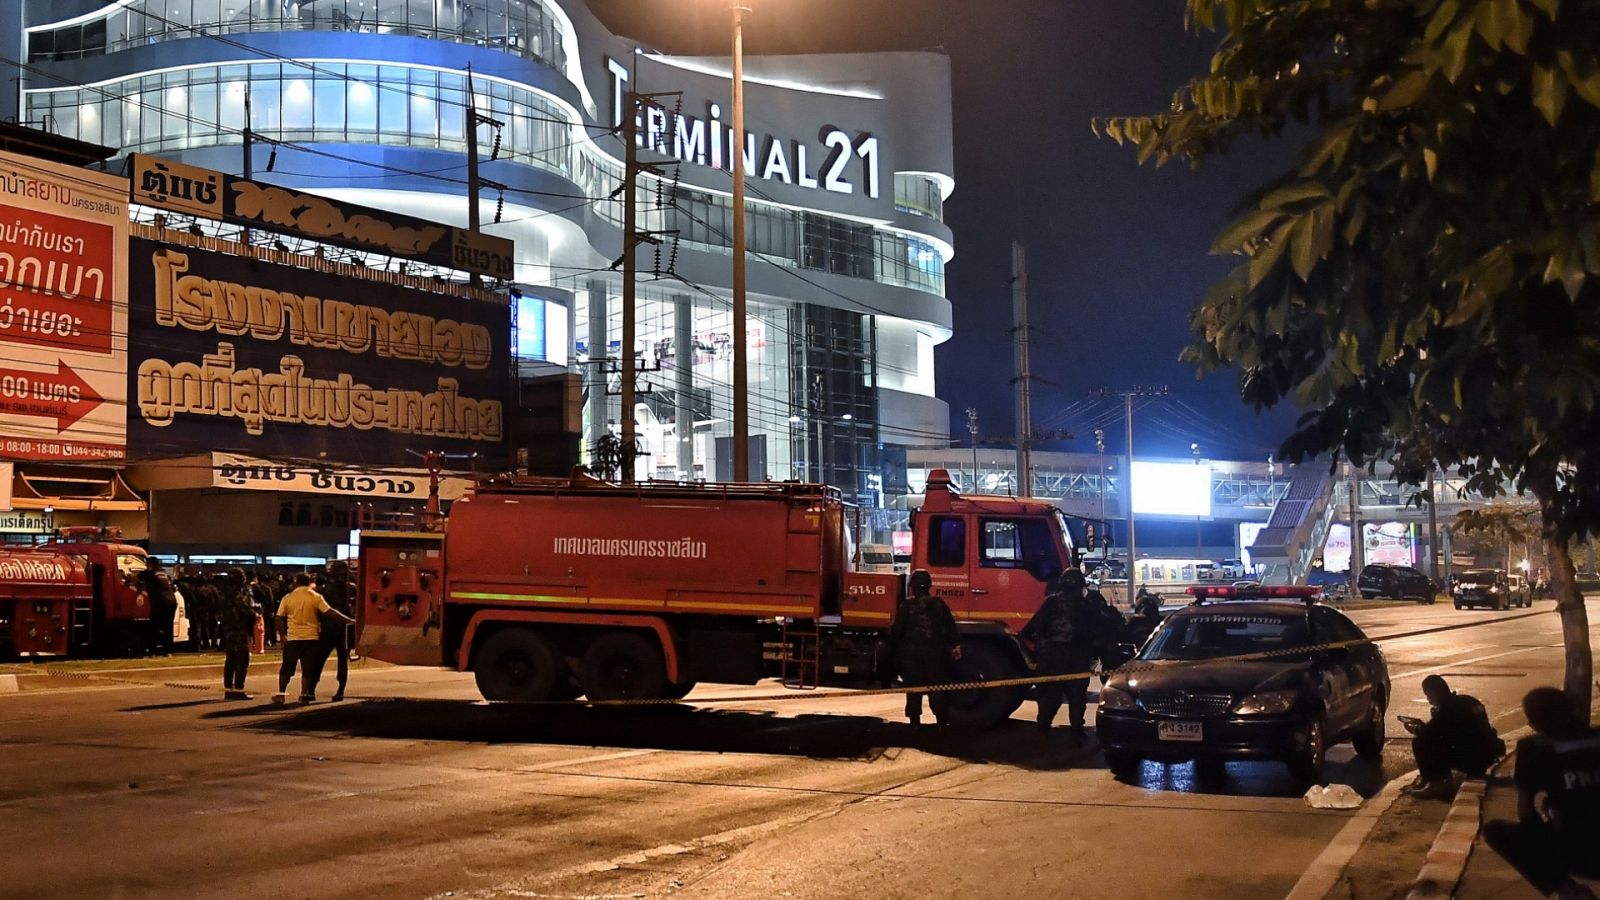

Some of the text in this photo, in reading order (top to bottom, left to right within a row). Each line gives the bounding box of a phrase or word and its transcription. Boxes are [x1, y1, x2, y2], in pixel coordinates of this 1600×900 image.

[141, 161, 217, 204] ตู้แช่
[824, 129, 880, 199] 21
[152, 249, 492, 370] โรงงานขายเอง
[0, 375, 28, 399] 00
[137, 341, 503, 442] ถูกที่สุดในประเทศไทย
[553, 537, 707, 559] เทศบาลนครนครราชสีมา
